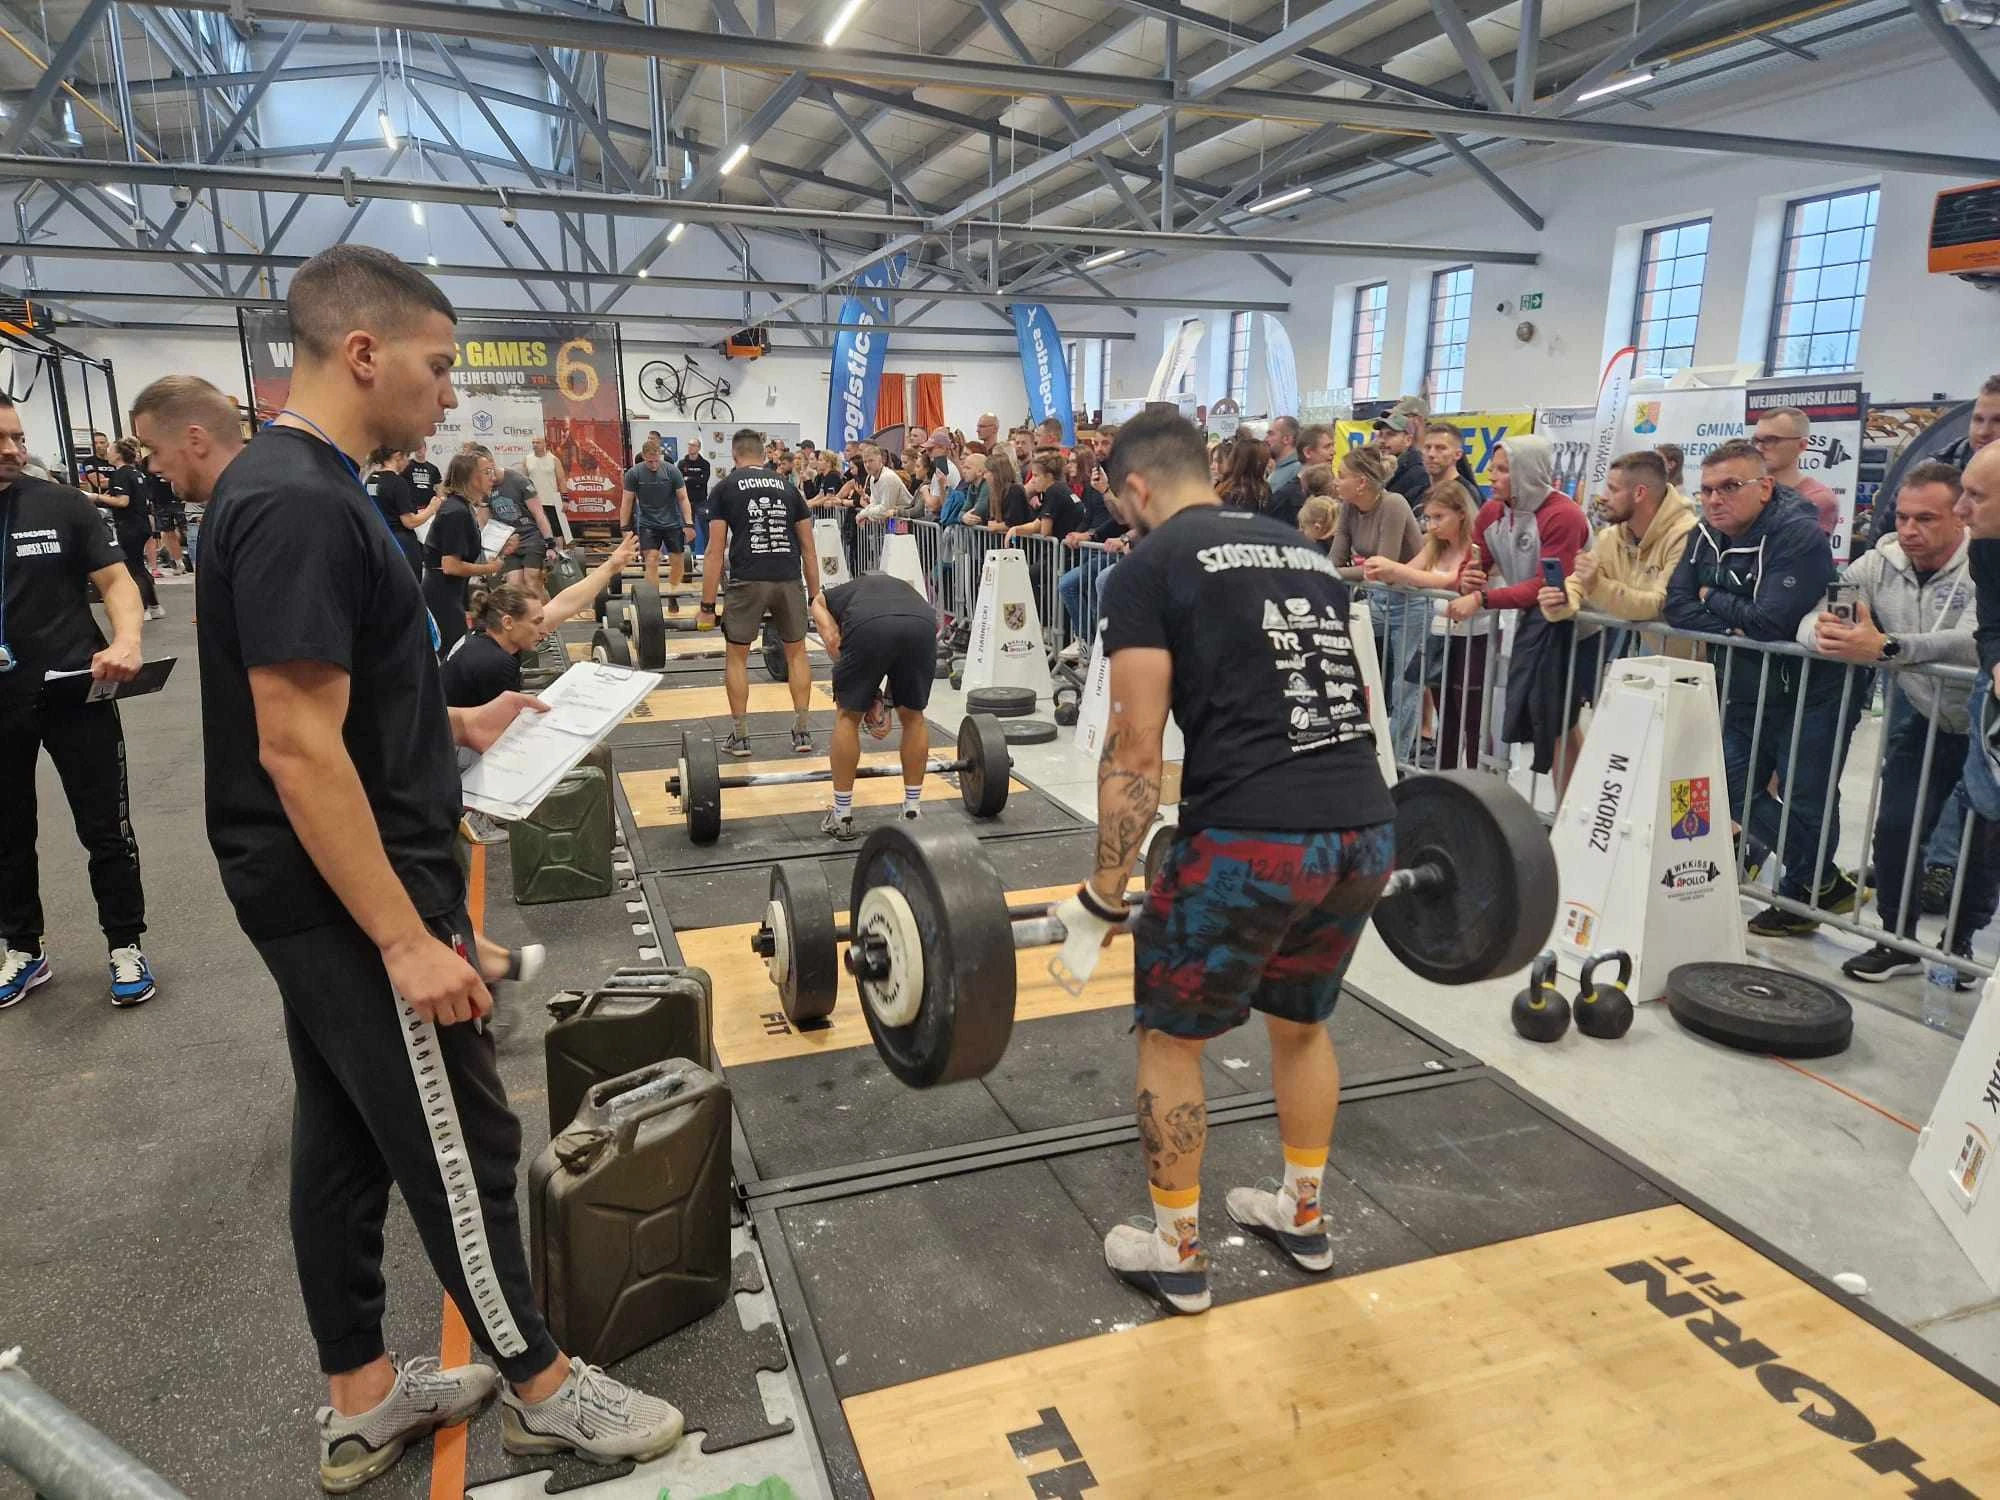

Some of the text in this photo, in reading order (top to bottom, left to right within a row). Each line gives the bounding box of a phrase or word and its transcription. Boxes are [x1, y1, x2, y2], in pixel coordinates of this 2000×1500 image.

[466, 341, 548, 368] GAMES
[556, 337, 600, 402] 6
[843, 311, 874, 442] ogistics
[1749, 389, 1857, 409] WEJHEROWSKI KLUB
[1697, 422, 1744, 437] GMINA
[738, 478, 785, 491] CICHOCKI
[42, 541, 62, 554] TEAM
[1268, 631, 1303, 651] TYR
[1589, 753, 1630, 854] M. SKORCZ
[1654, 1256, 1747, 1306] FIT
